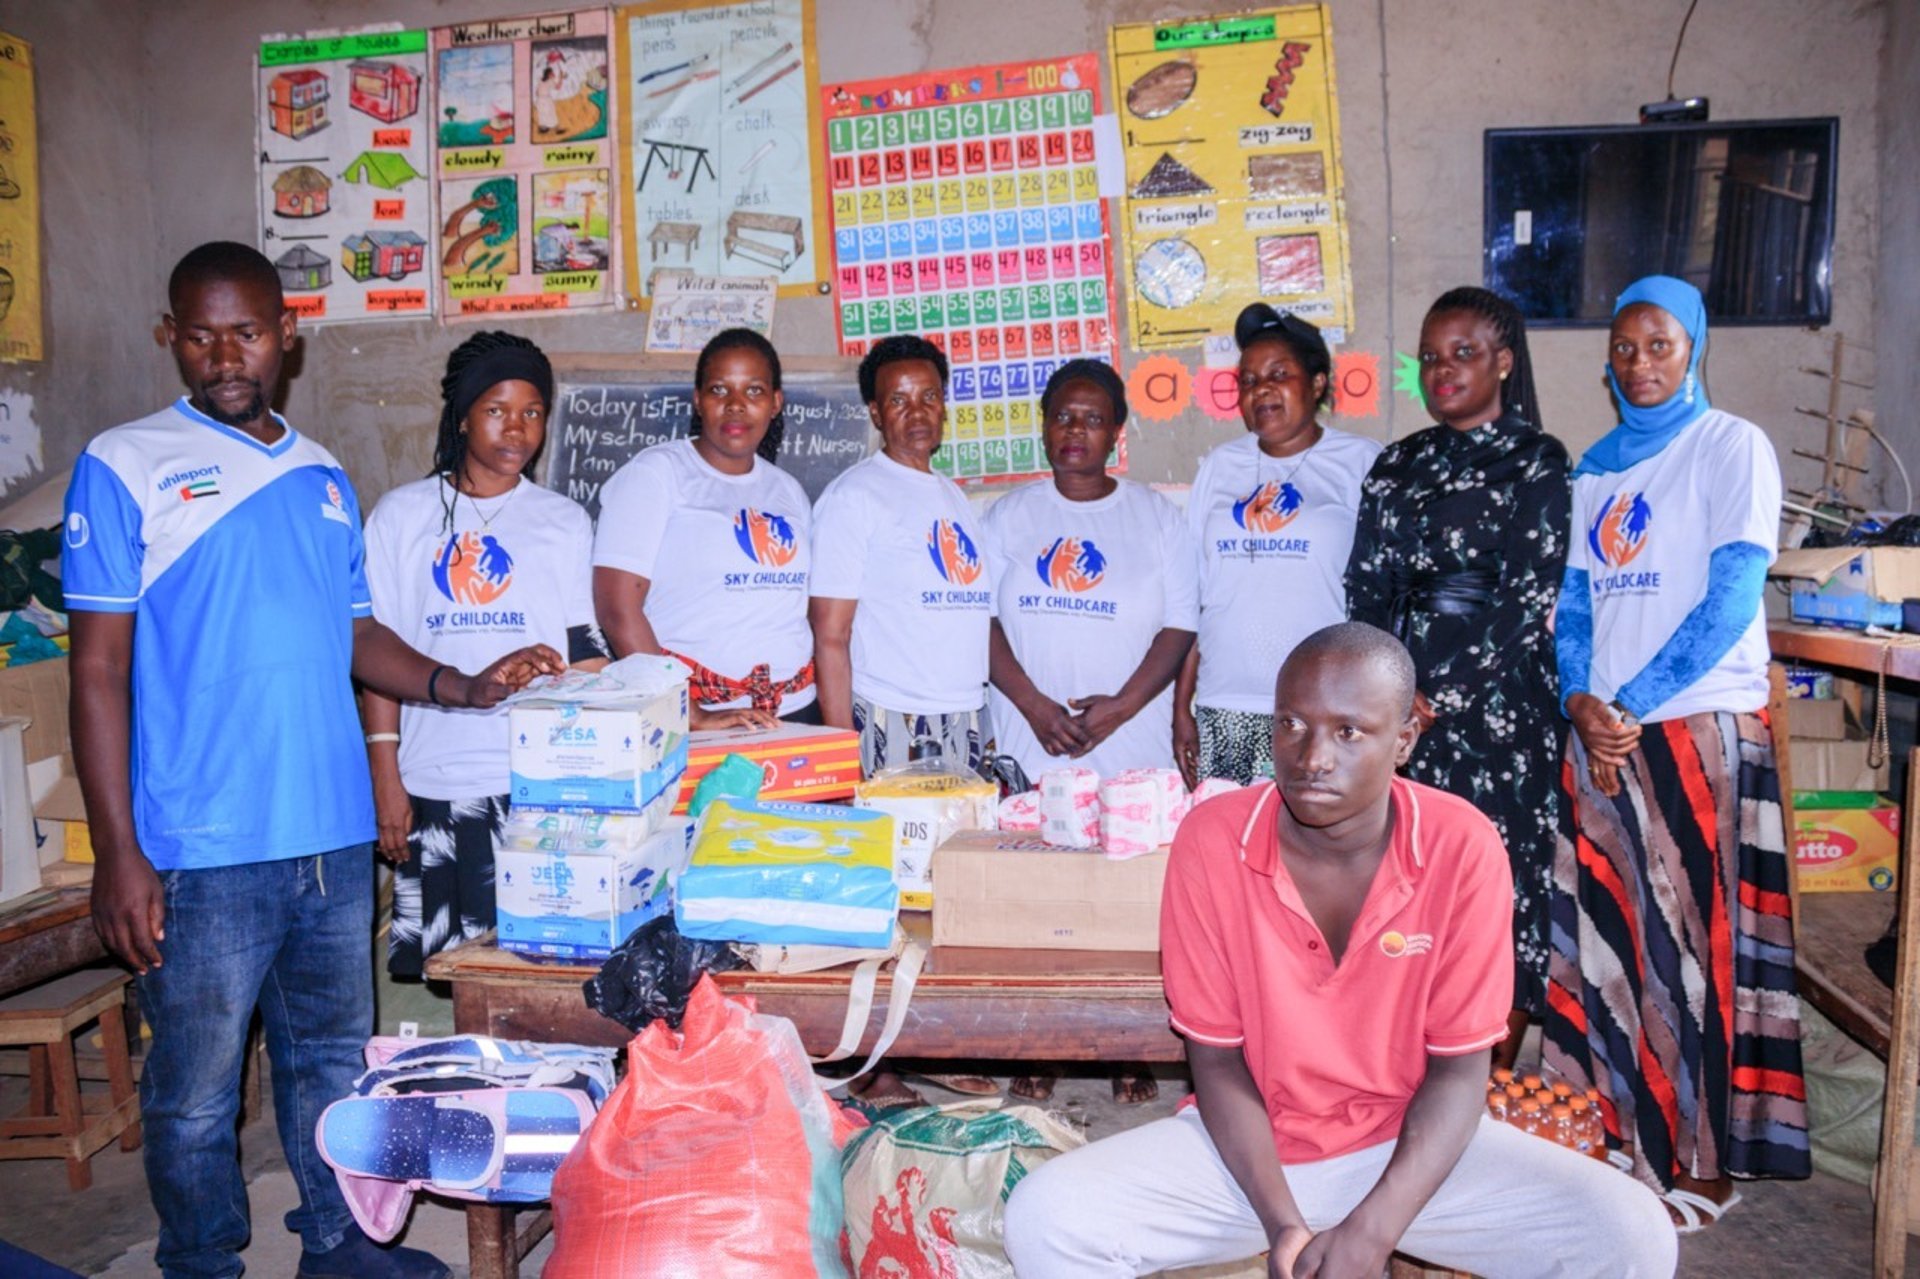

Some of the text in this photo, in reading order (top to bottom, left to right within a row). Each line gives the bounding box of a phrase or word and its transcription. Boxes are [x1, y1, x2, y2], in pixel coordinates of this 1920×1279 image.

[453, 13, 574, 43] Weather chart
[640, 15, 675, 35] Things
[730, 21, 778, 52] pencils
[643, 38, 676, 60] pens
[735, 108, 775, 132] chalk
[834, 95, 1088, 144] 1 2 3 4 5 6 7 8 9 10
[1241, 124, 1312, 144] zig-zag
[445, 151, 502, 168] cloudy
[546, 149, 596, 164] rainy
[835, 132, 1093, 180] 11 12 13 14 15 16 17 18 19 20
[735, 183, 770, 207] desk
[837, 169, 1096, 212] 21 22 23 24 25 26 27 28 29 30
[647, 200, 692, 220] tables
[1137, 203, 1214, 225] triangle
[1246, 201, 1329, 224] rectangle
[839, 232, 855, 248] 31
[864, 229, 883, 246] 32
[889, 226, 909, 242] 33
[916, 223, 935, 239] 34
[942, 220, 962, 236] 35
[969, 217, 988, 233] 36
[995, 214, 1016, 230] 37
[1023, 211, 1044, 228] 38
[1077, 205, 1098, 222] 40
[842, 244, 1100, 284] 41 42 43 44 45 46 47 48 49 50
[452, 272, 504, 291] windy
[677, 277, 769, 291] Wild animals
[845, 307, 859, 322] 51
[869, 302, 888, 319] 52
[896, 299, 915, 316] 53
[921, 296, 941, 313] 54
[949, 294, 968, 310] 55
[975, 292, 995, 309] 56
[1002, 289, 1022, 306] 57
[1029, 286, 1048, 303] 58
[1084, 281, 1104, 299] 60
[952, 333, 971, 348] 65
[979, 330, 998, 346] 66
[1005, 327, 1025, 344] 67
[1032, 324, 1052, 341] 68
[954, 371, 973, 388] 75
[981, 369, 1000, 386] 76
[1007, 366, 1027, 383] 77
[1145, 372, 1177, 403] a
[1211, 370, 1240, 411] e
[566, 388, 636, 429] Today
[642, 393, 661, 418] is
[782, 400, 837, 431] ugust,
[957, 403, 1030, 424] 85 86 87
[564, 423, 598, 455] My
[600, 417, 677, 446] school
[807, 434, 867, 460] Nursery
[986, 442, 1006, 459] 96
[1013, 440, 1031, 456] 97
[569, 448, 616, 474] I am
[157, 464, 223, 491] uhlsport
[568, 479, 599, 506] My
[1216, 538, 1310, 553] SKY CHILDCARE
[724, 573, 750, 586] SKY
[921, 591, 942, 604] SKY
[1018, 595, 1117, 615] SKY CHILDCARE
[451, 611, 526, 626] CHILDCARE
